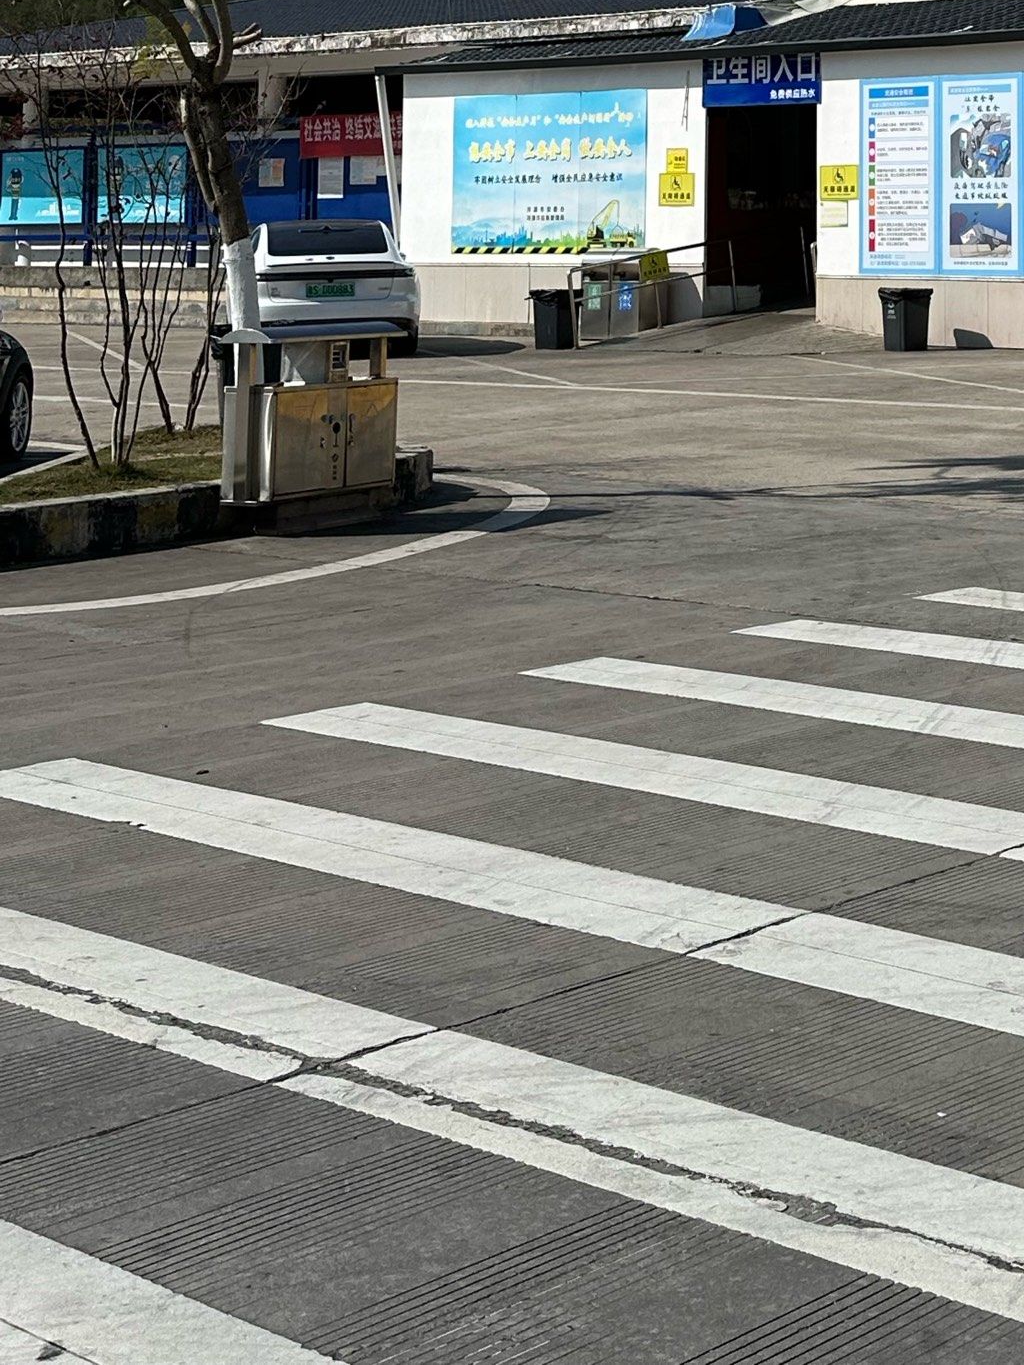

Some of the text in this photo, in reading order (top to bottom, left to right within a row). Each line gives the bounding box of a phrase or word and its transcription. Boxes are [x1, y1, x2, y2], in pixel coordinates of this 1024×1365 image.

[706, 51, 817, 85] 卫生间入口
[769, 88, 816, 100] 免费供应热水
[304, 117, 341, 142] 社会共治
[551, 171, 623, 184] 增强全民应急安全意识
